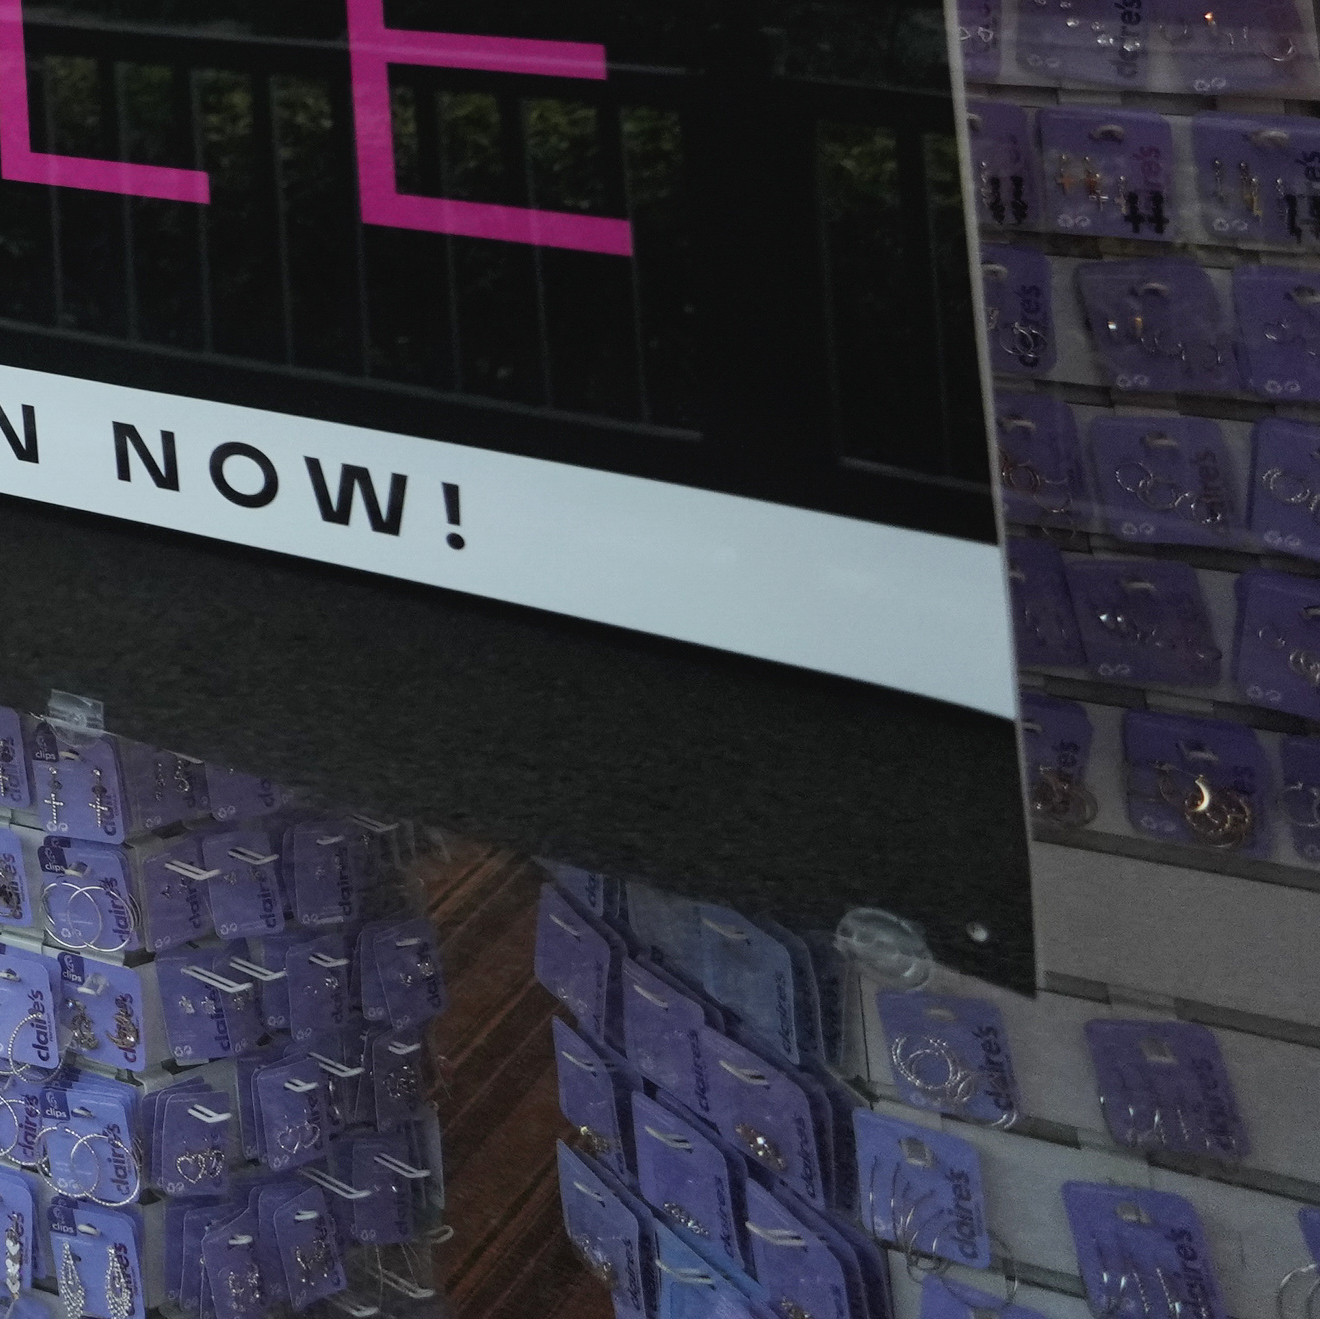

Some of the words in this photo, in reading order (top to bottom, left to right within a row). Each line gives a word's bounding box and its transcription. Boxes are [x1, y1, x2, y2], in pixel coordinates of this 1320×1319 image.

[113, 422, 465, 551] NOW!
[35, 750, 56, 761] clips
[62, 969, 83, 982] clips
[45, 1106, 67, 1119] clips
[943, 1170, 980, 1260] claire's
[52, 1223, 74, 1234] clips
